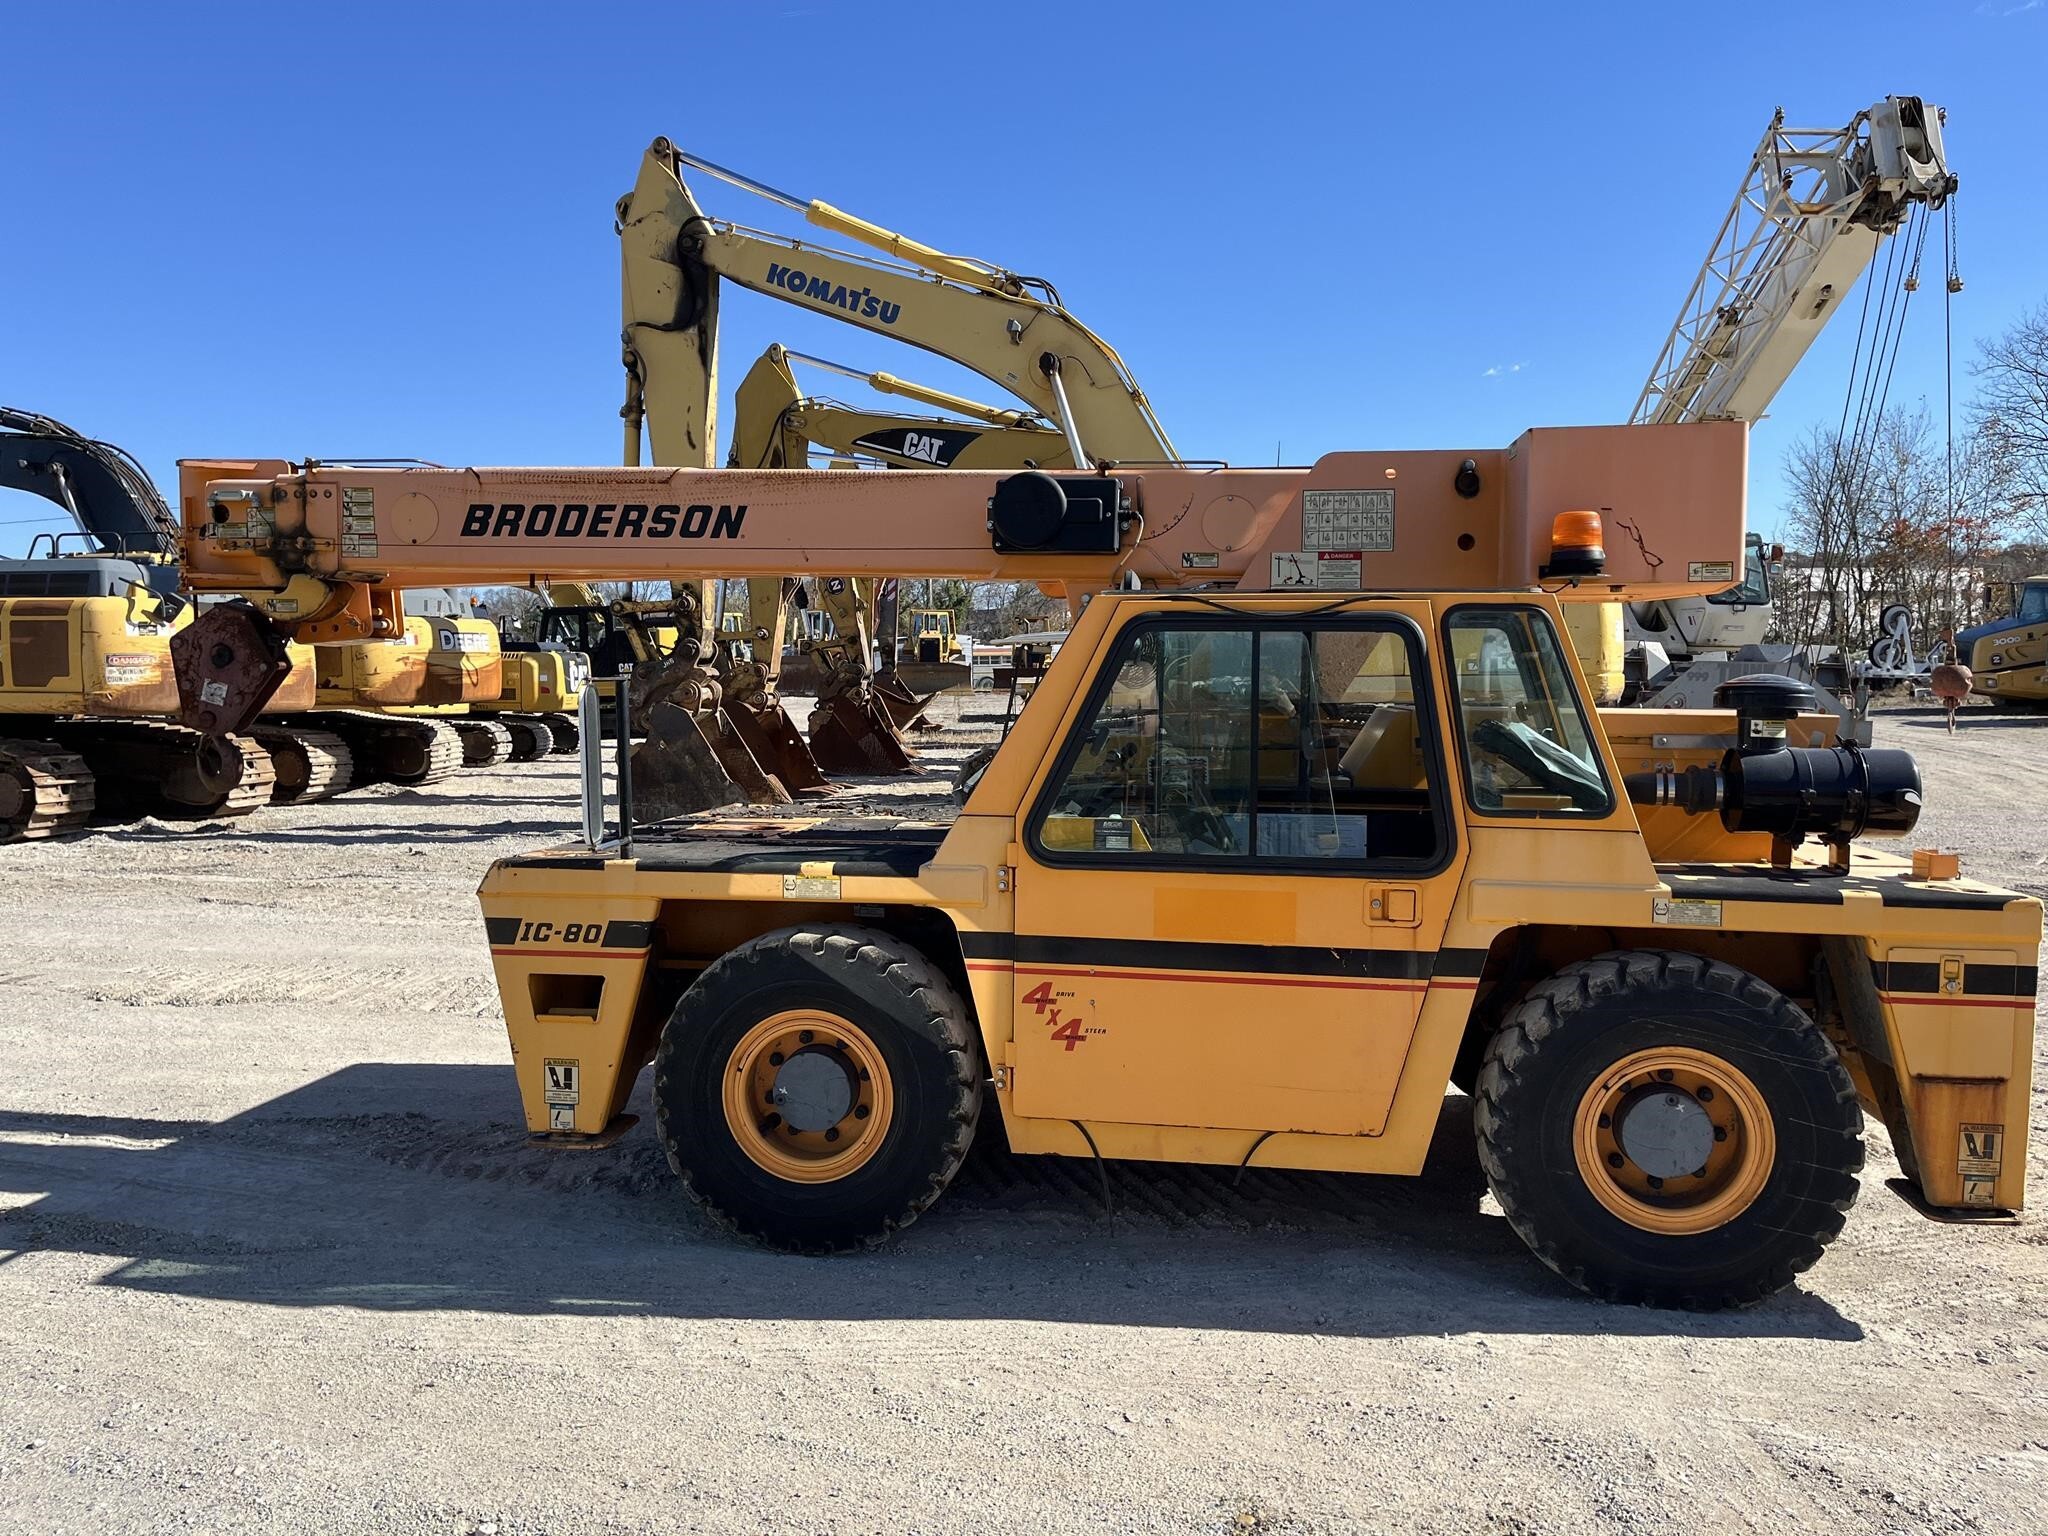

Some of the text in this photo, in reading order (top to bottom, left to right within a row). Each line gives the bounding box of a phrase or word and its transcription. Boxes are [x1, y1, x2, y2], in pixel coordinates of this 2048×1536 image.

[766, 263, 901, 324] KOMATSU
[903, 432, 943, 463] CAT
[460, 504, 747, 538] BRODERSON
[830, 580, 841, 591] Z
[440, 629, 489, 652] DEERE
[618, 662, 634, 673] CAT
[520, 923, 602, 943] IC-80
[1022, 982, 1057, 1014] 4
[1050, 1018, 1087, 1051] 4
